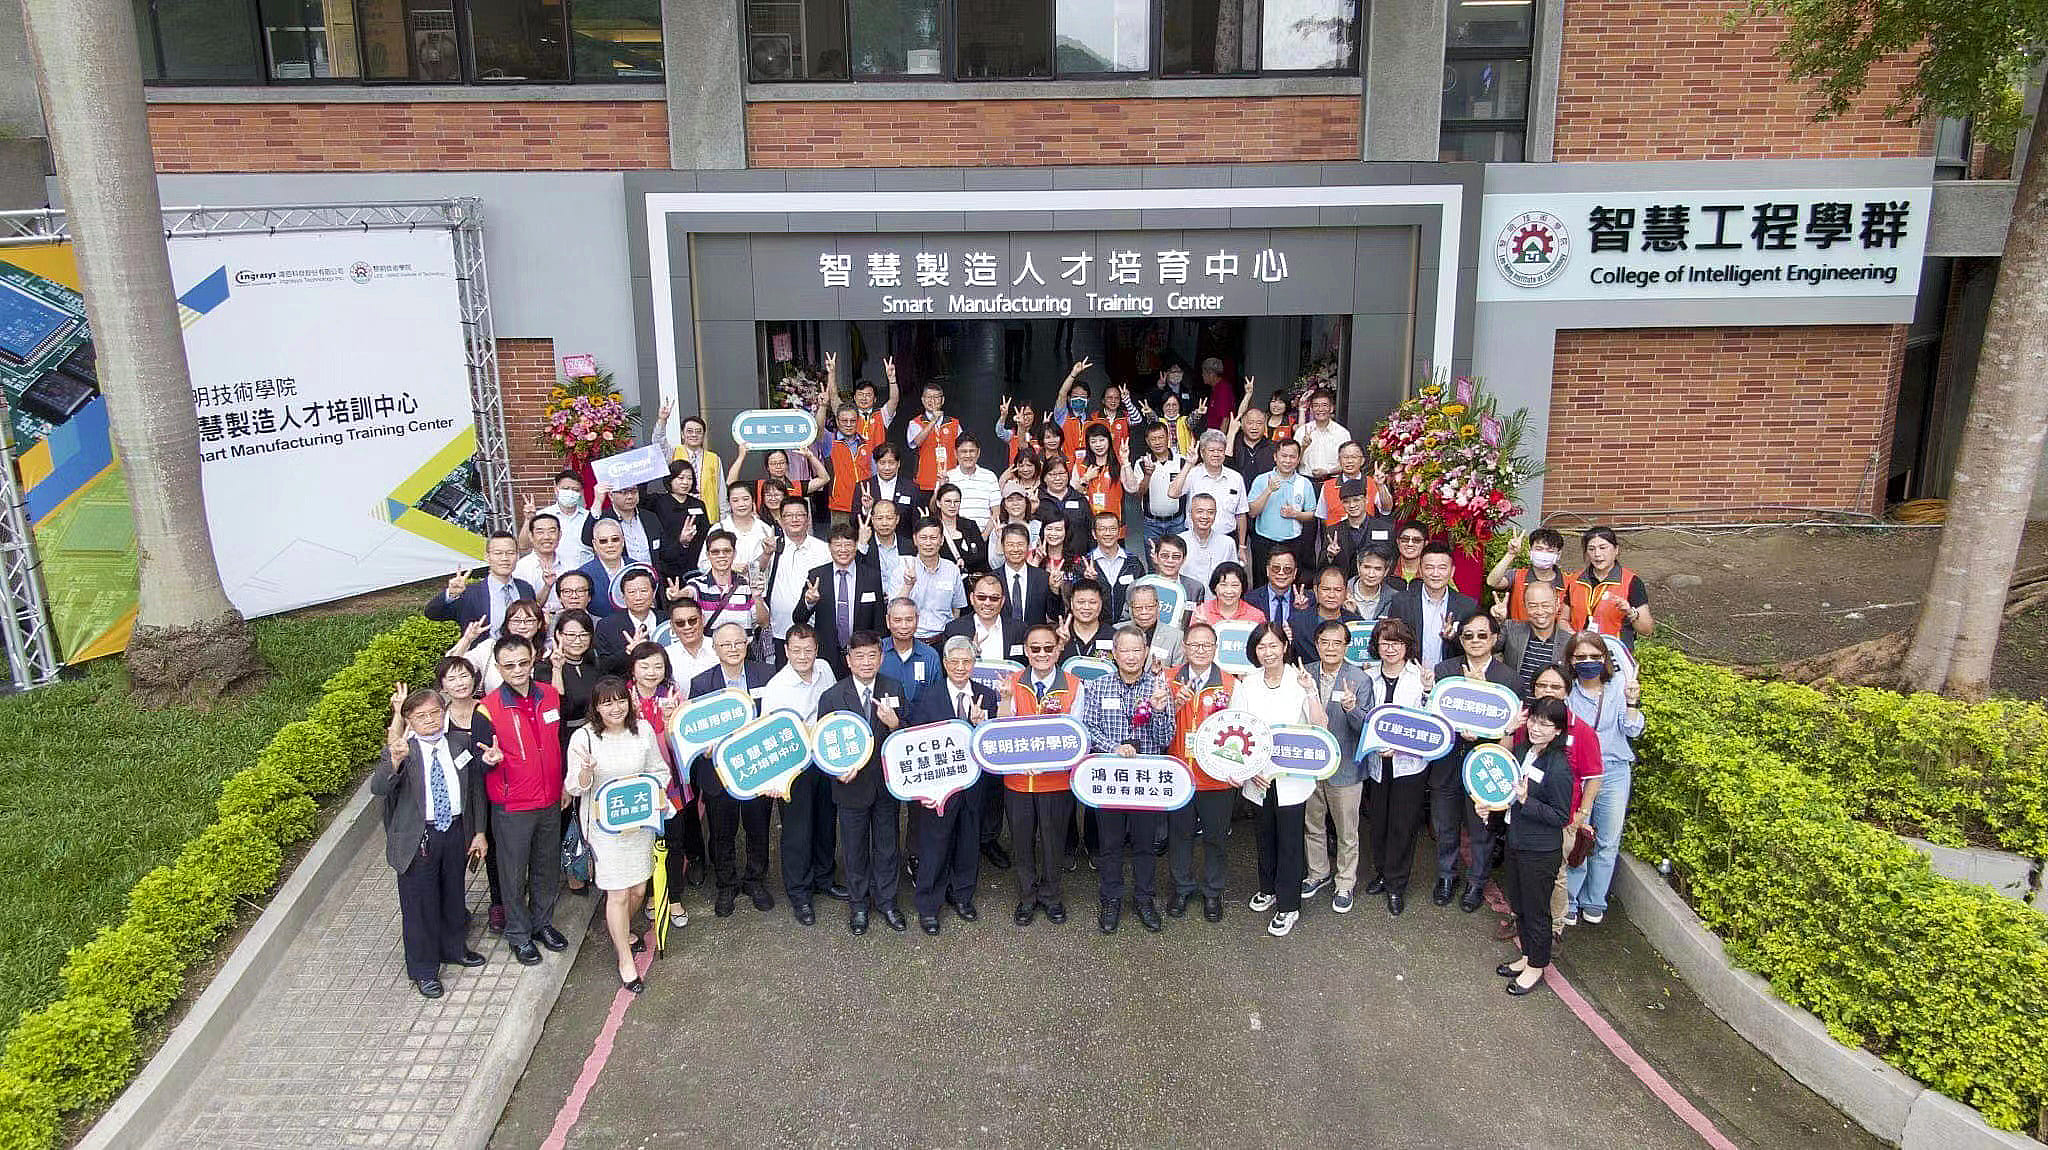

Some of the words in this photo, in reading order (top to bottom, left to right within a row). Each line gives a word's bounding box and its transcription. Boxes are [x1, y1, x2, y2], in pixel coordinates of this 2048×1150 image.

[1588, 201, 1911, 253] 智慧工程學群
[818, 250, 1288, 288] 智慧製造人才培育中心
[1590, 267, 1659, 287] College
[1665, 265, 1686, 283] of
[1688, 263, 1782, 284] Intelligent
[1786, 262, 1898, 284] Engineering
[882, 295, 933, 313] Smart
[948, 293, 1071, 316] Manufacturing
[1086, 293, 1153, 315] Training
[1167, 292, 1224, 310] Center
[192, 376, 298, 408] 明技術學院
[199, 391, 419, 443] 慧製造人才培訓中心
[200, 448, 232, 463] art
[231, 433, 344, 459] Manufacturing
[345, 423, 405, 442] Training
[408, 417, 454, 433] Center
[823, 726, 857, 745] 智慧
[982, 735, 1079, 755] 黎明技術學院
[730, 727, 795, 770] 智慧製造
[826, 741, 861, 760] 製造
[899, 748, 966, 774] 智慧製造
[902, 764, 968, 785] 人才培訓基地
[1091, 767, 1174, 784] 鴻佰科技
[610, 791, 649, 809] 五大
[1092, 784, 1173, 797] 股份有限公司
